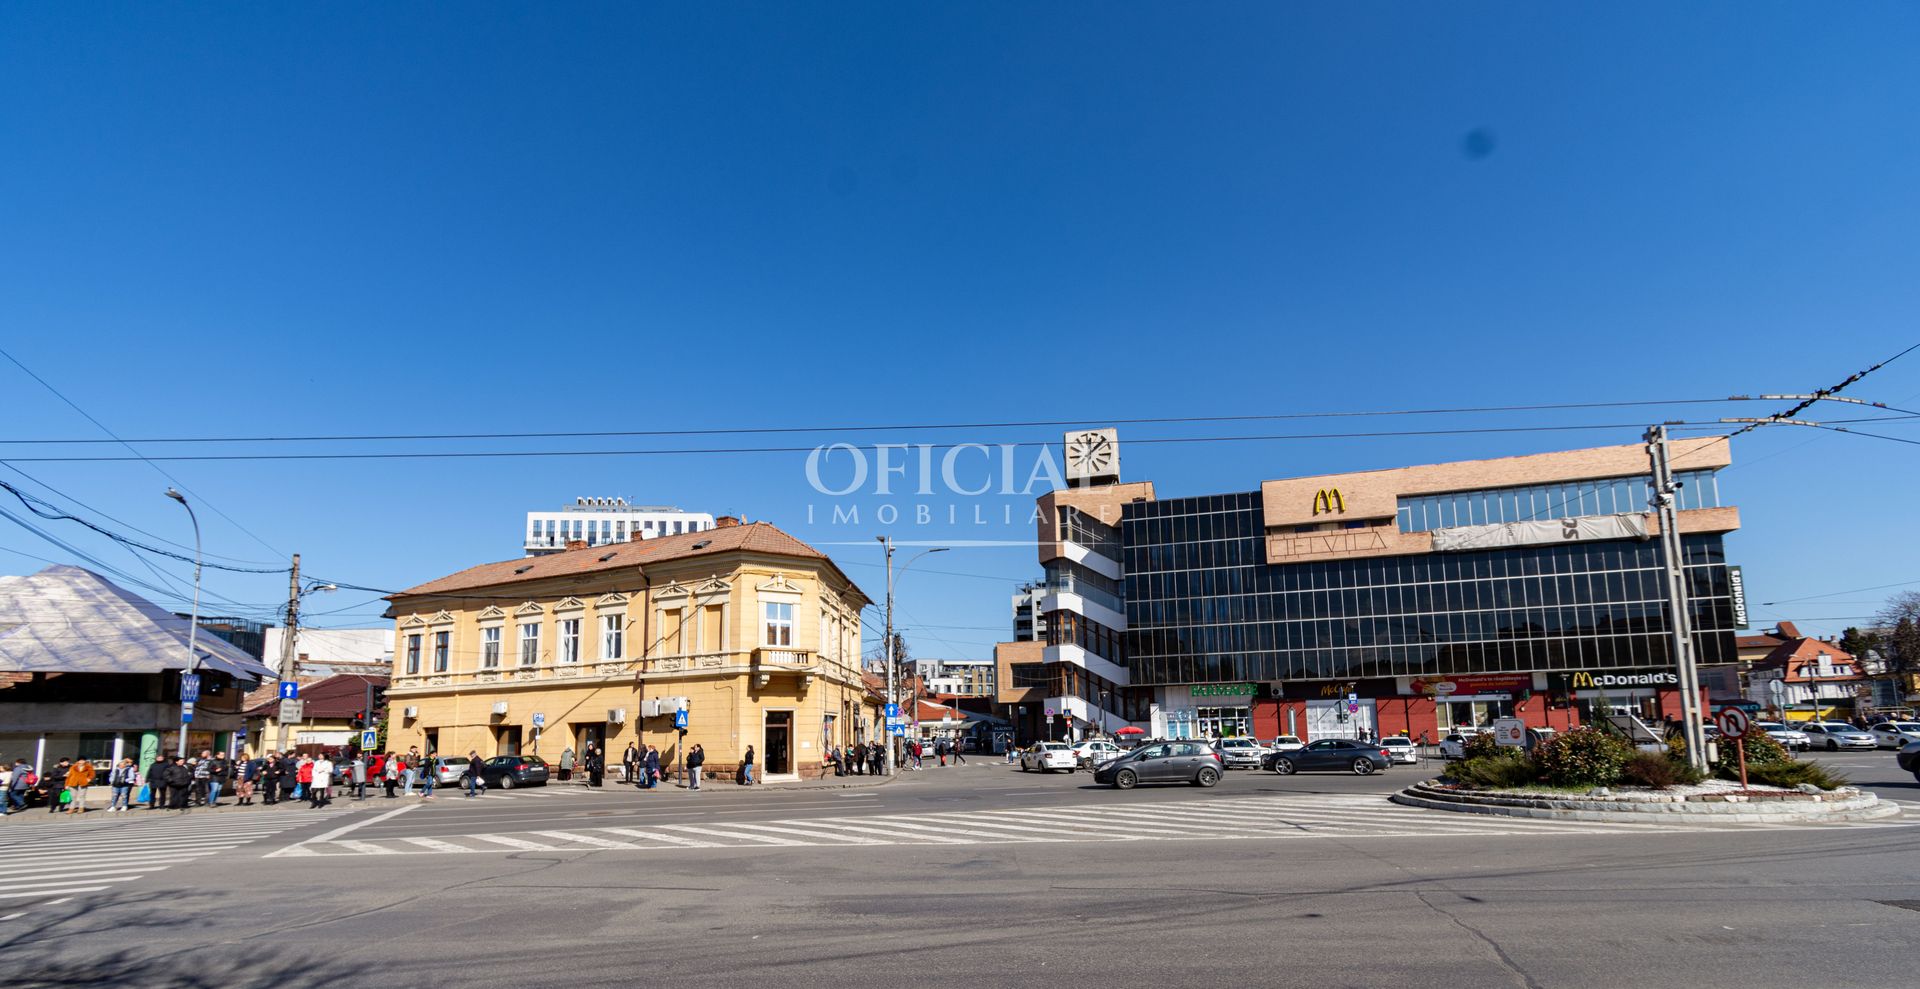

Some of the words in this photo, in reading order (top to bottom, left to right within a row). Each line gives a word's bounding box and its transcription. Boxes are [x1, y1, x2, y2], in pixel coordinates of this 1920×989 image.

[1731, 570, 1747, 625] McDonald's
[1573, 671, 1678, 688] McDonald's
[1191, 683, 1258, 697] FARMACIE
